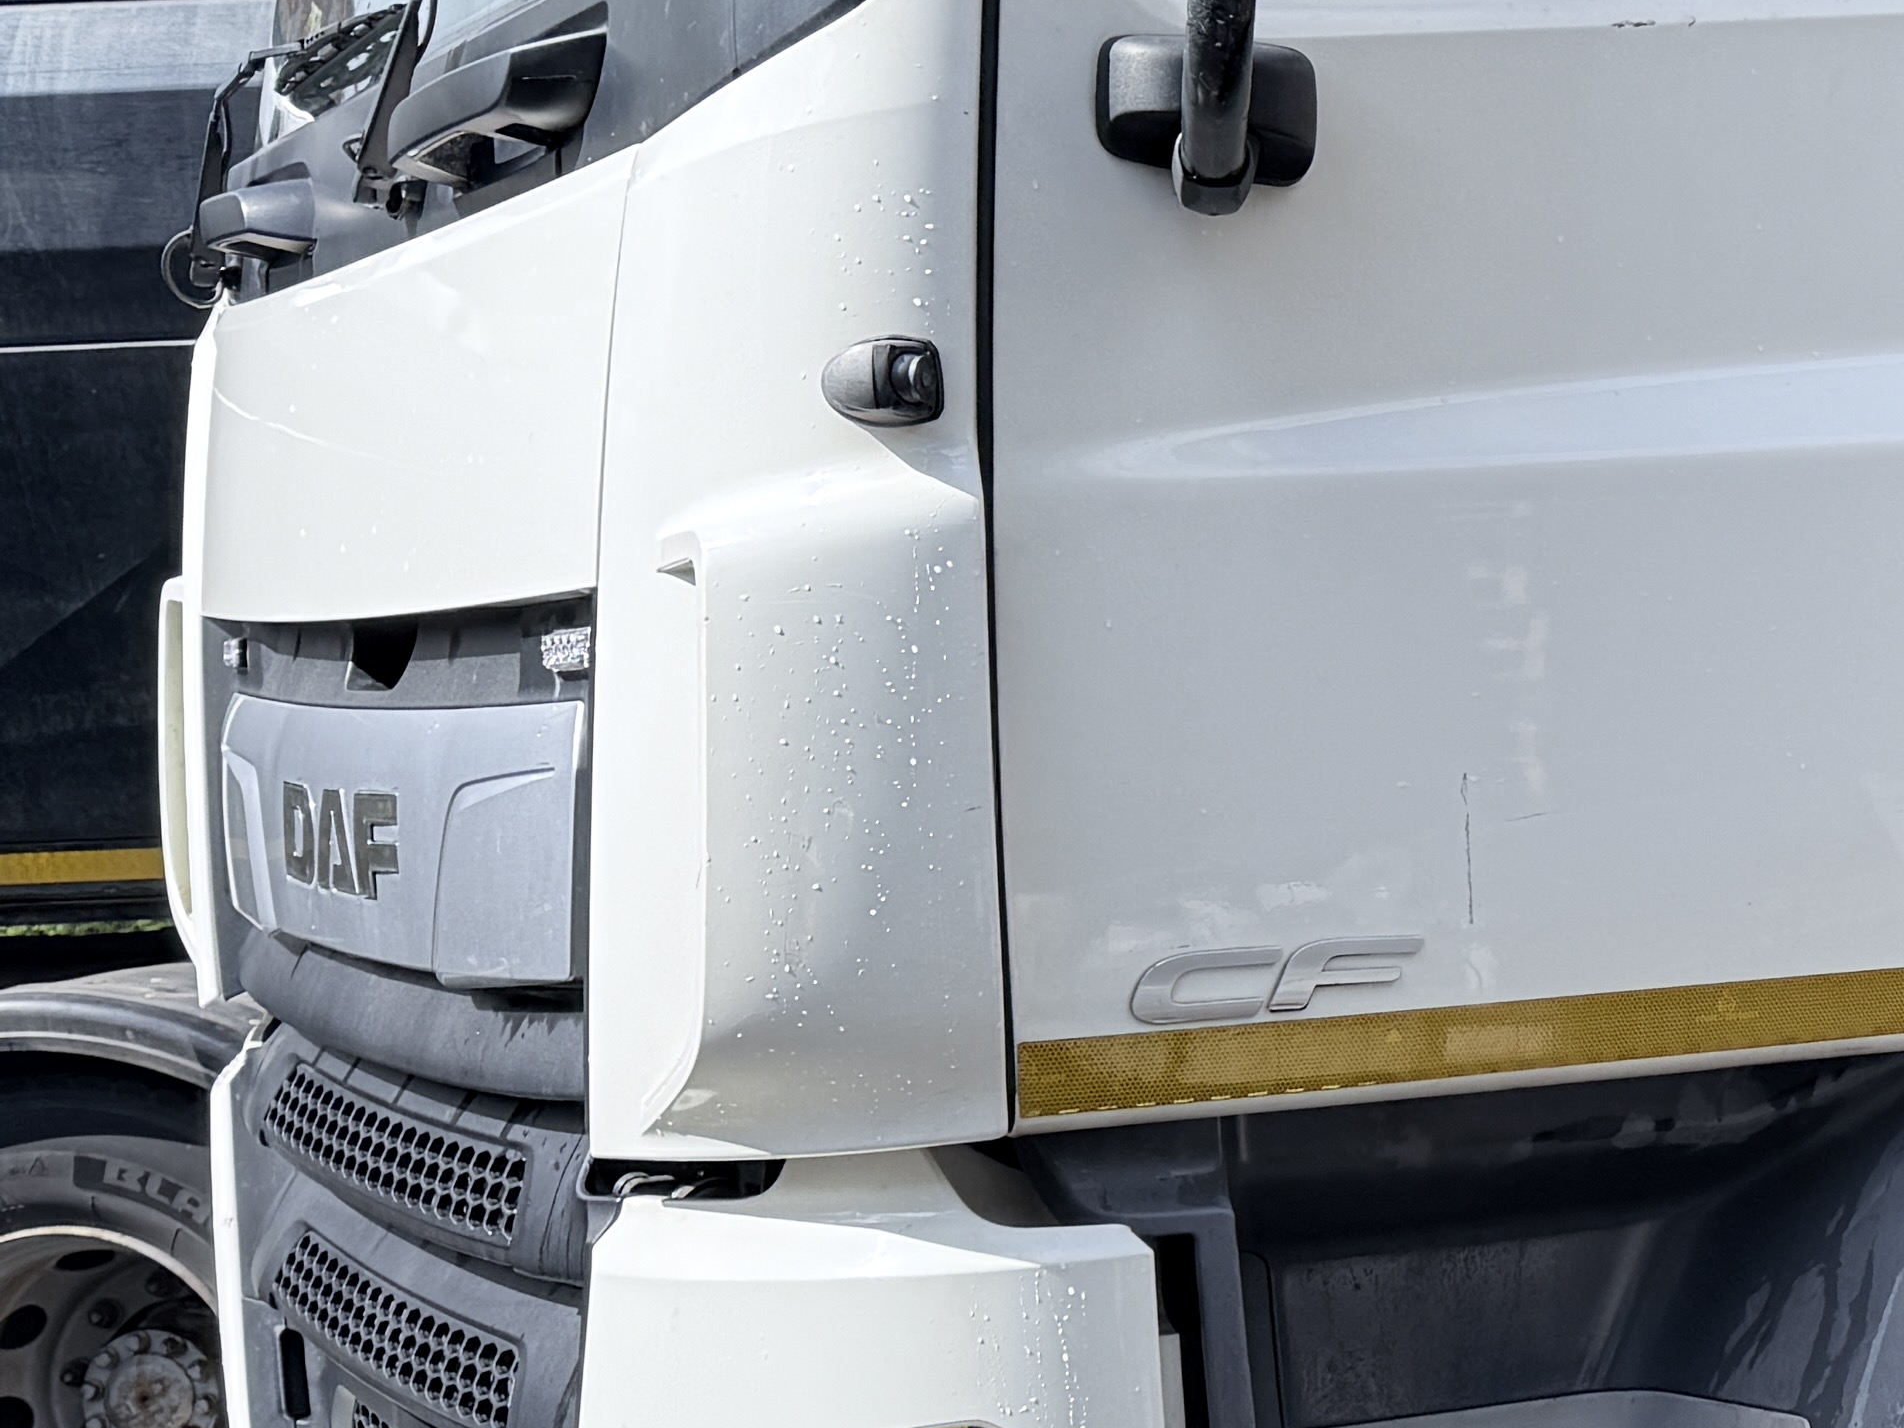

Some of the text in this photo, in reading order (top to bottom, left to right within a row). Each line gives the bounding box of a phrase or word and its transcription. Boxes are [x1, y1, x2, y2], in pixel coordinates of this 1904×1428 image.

[283, 780, 400, 901] DAF
[1129, 934, 1425, 1025] CF
[103, 1159, 212, 1226] BLA
